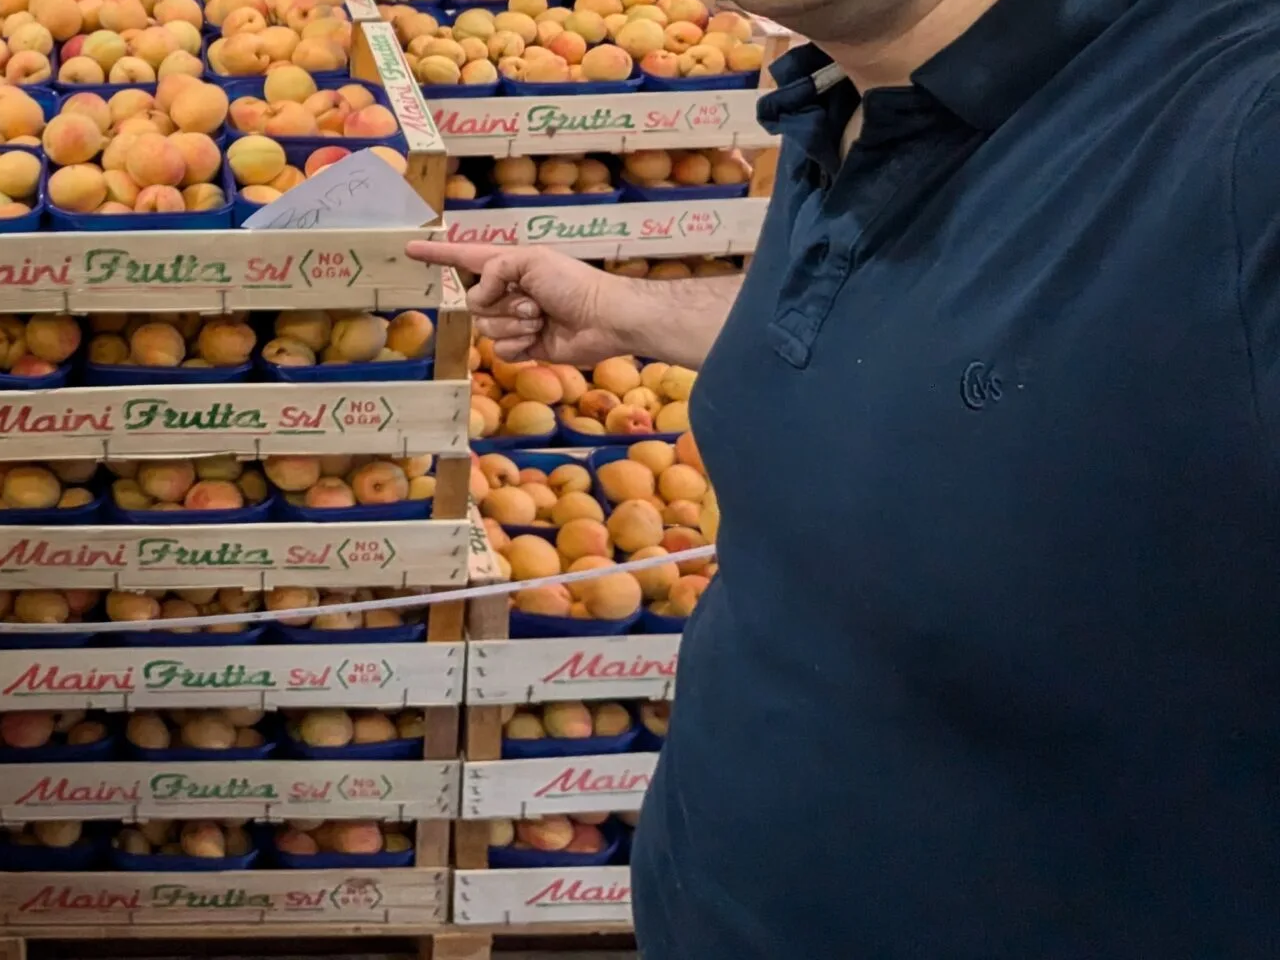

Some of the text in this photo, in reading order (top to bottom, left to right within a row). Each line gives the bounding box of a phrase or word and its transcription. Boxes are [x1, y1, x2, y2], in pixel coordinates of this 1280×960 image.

[431, 105, 681, 135] Maini Frutta Srl
[527, 215, 631, 239] Frutta
[640, 217, 675, 235] Srl
[84, 248, 232, 284] Frutta
[244, 256, 293, 282] Srl
[318, 253, 345, 265] NO
[123, 399, 267, 429] Frutta
[278, 404, 327, 428] Srl
[350, 400, 376, 413] NO
[138, 538, 273, 566] Frutta
[286, 544, 330, 565] Srl
[355, 541, 380, 551] NO
[3, 660, 330, 695] Maini Frutta Srl
[353, 662, 377, 673] NO
[543, 650, 678, 682] Maini
[16, 773, 331, 804] Maini Frutta Srl
[533, 767, 651, 797] Main
[21, 885, 324, 911] Maini Frutta Srl
